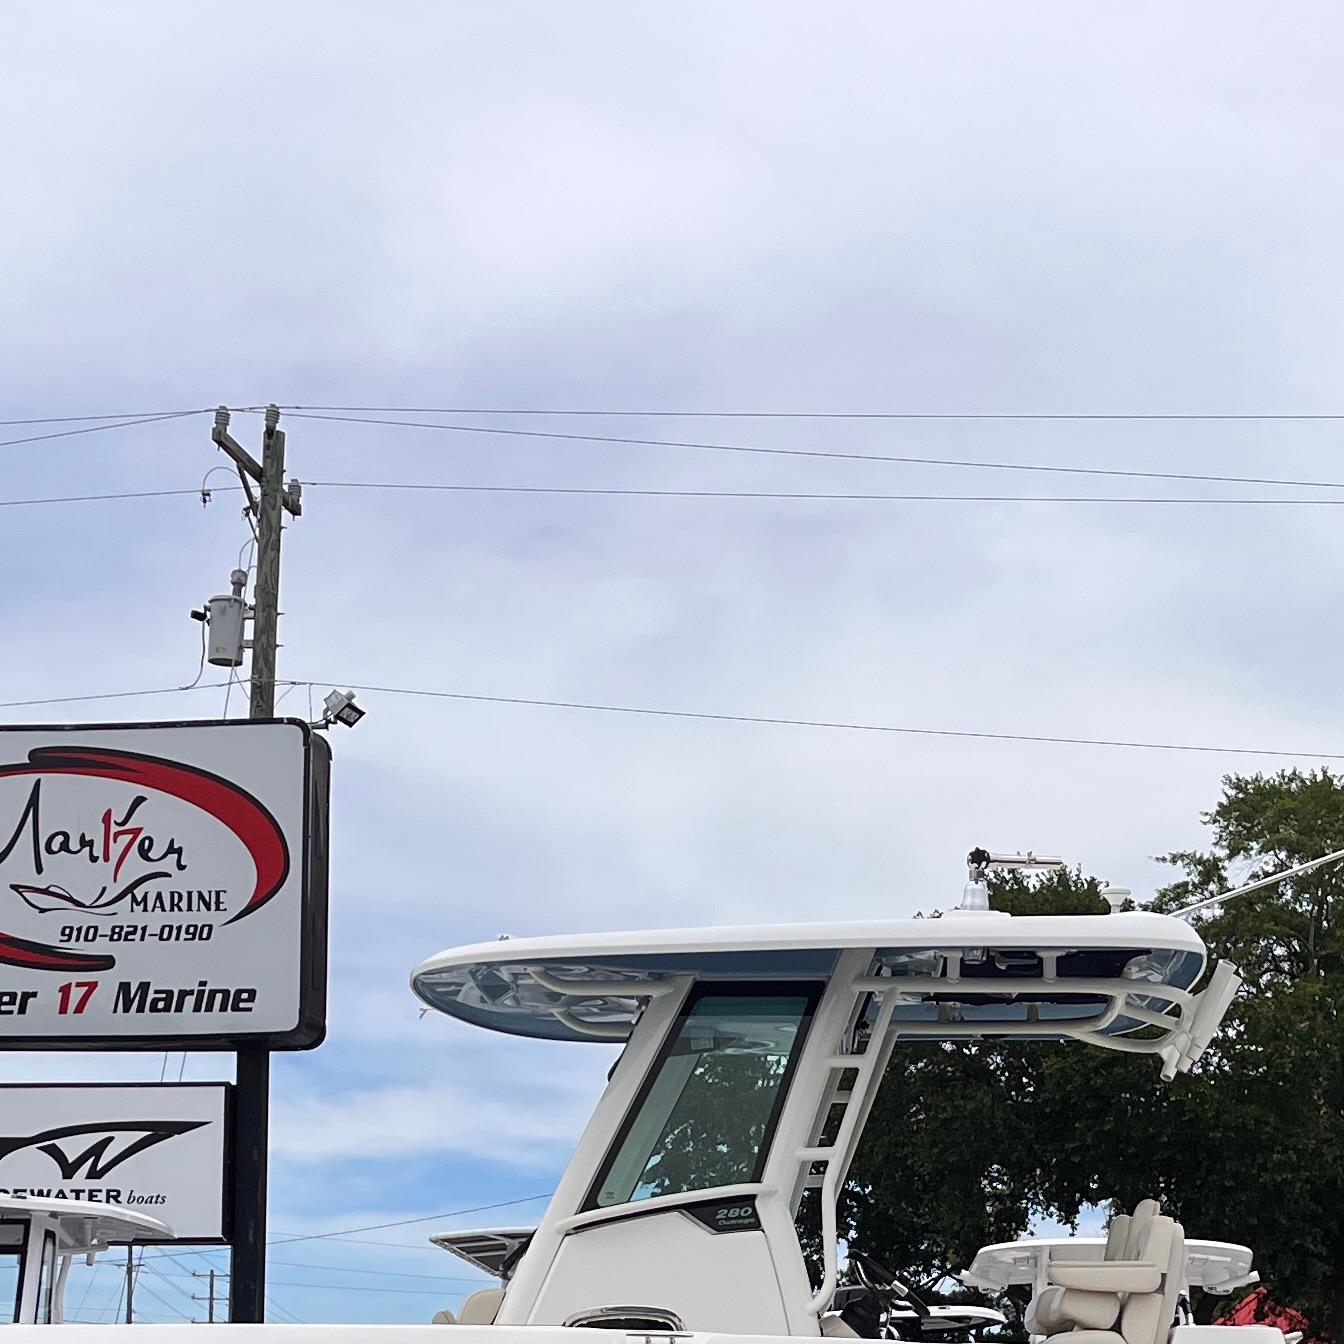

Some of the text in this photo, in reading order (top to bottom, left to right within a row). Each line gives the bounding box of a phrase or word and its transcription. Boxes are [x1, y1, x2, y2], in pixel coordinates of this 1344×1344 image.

[130, 889, 227, 912] MARINE
[59, 923, 213, 942] 910-821-0190
[57, 981, 98, 1015] 17
[112, 980, 256, 1015] Marine
[126, 1189, 167, 1205] boats
[715, 1206, 753, 1219] 280
